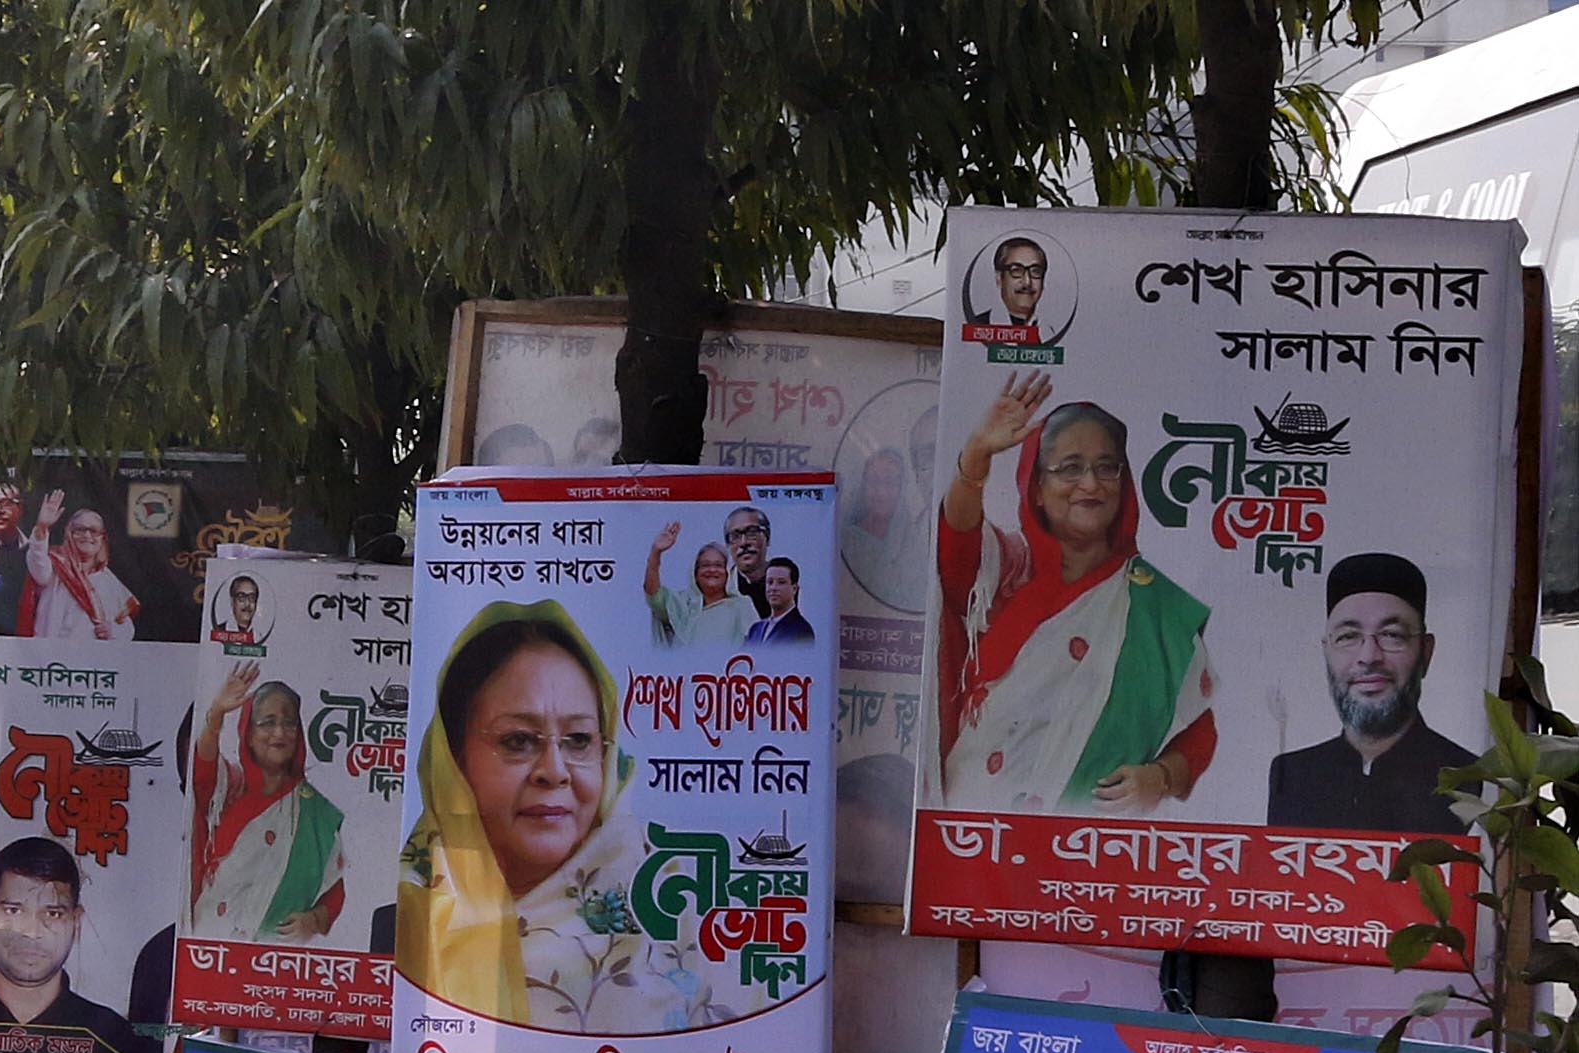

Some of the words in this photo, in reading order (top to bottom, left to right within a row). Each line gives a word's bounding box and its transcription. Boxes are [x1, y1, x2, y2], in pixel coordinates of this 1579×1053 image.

[1136, 257, 1252, 306] শেখ
[1265, 250, 1489, 311] হাসিনার
[1216, 328, 1375, 374] সালাম
[1389, 321, 1484, 377] নিন
[1141, 413, 1328, 529] নৌকায়
[440, 515, 541, 549] উন্নয়নের
[552, 518, 605, 547] ধারা
[1211, 487, 1328, 551] ভোট
[427, 560, 525, 588] অব্যাহত
[535, 558, 616, 587] রাখতে
[1254, 534, 1323, 590] দিন
[308, 592, 371, 622] শেখ
[17, 662, 119, 690] হাসিনার
[42, 694, 87, 708] সালাম
[92, 692, 117, 710] নিন
[623, 665, 684, 738] শেখ
[691, 654, 813, 748] হাসিনার
[648, 754, 745, 795] সালাম
[752, 745, 811, 795] নিন
[933, 818, 1026, 865] ডা.
[1052, 824, 1251, 885] এনামুর
[630, 822, 808, 941] নৌকায়
[1039, 879, 1118, 905] সংসদ
[1228, 887, 1347, 916] ঢাকা-১৯
[699, 896, 807, 962] ভোট
[1120, 914, 1181, 939] ঢাকা
[1194, 918, 1265, 943] জেলা
[1273, 919, 1394, 948] আওয়ামী
[186, 944, 237, 975] ডা.
[251, 951, 360, 990] এনামুর
[243, 983, 288, 999] সংসদ
[740, 942, 806, 1000] দিন
[287, 1007, 324, 1021] ঢাকা
